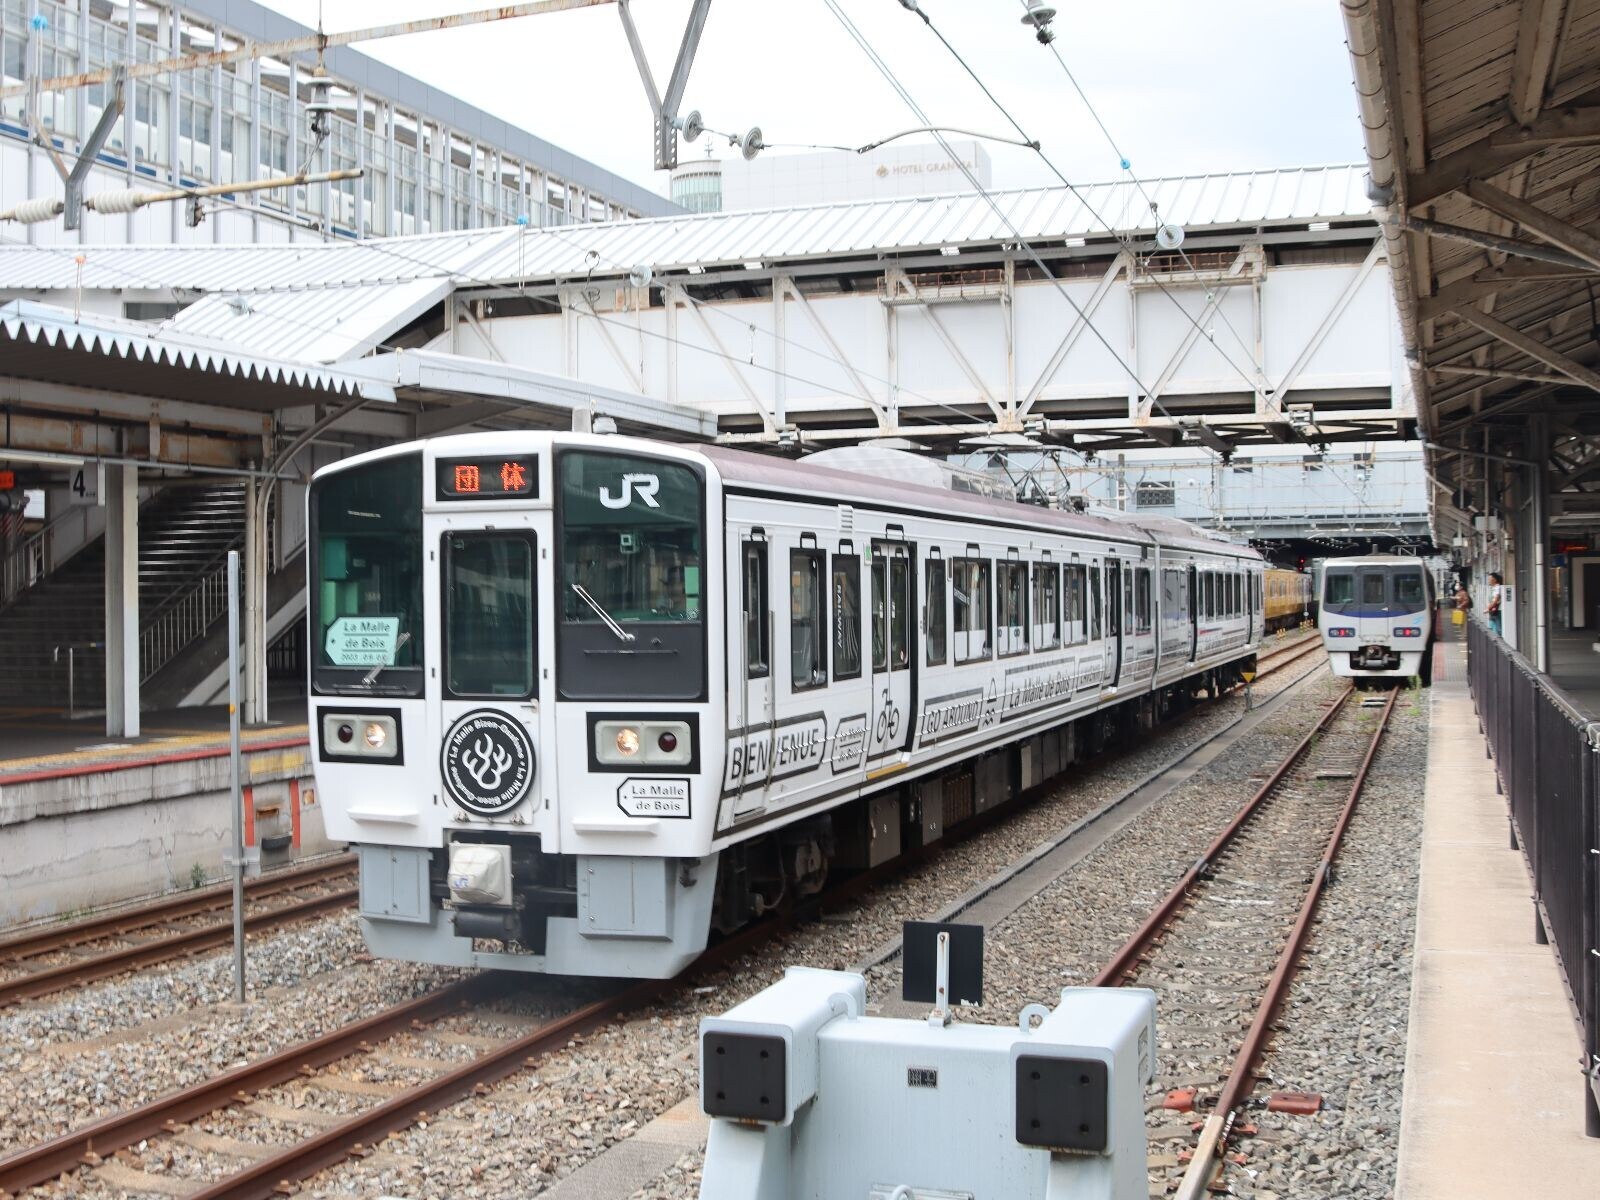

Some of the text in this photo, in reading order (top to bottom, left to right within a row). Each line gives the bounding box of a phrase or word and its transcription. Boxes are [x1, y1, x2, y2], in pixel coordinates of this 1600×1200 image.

[892, 160, 972, 175] HOTEL GRANA
[73, 469, 86, 498] 4
[599, 472, 660, 509] JR
[343, 621, 391, 633] La Malle
[345, 638, 385, 649] de Bois
[453, 724, 475, 745] Malle
[449, 746, 459, 758] La
[731, 728, 819, 780] BIENVENUE
[516, 766, 526, 780] La
[501, 779, 522, 800] Malle
[632, 786, 684, 795] La Malle
[636, 801, 681, 810] de Bois
